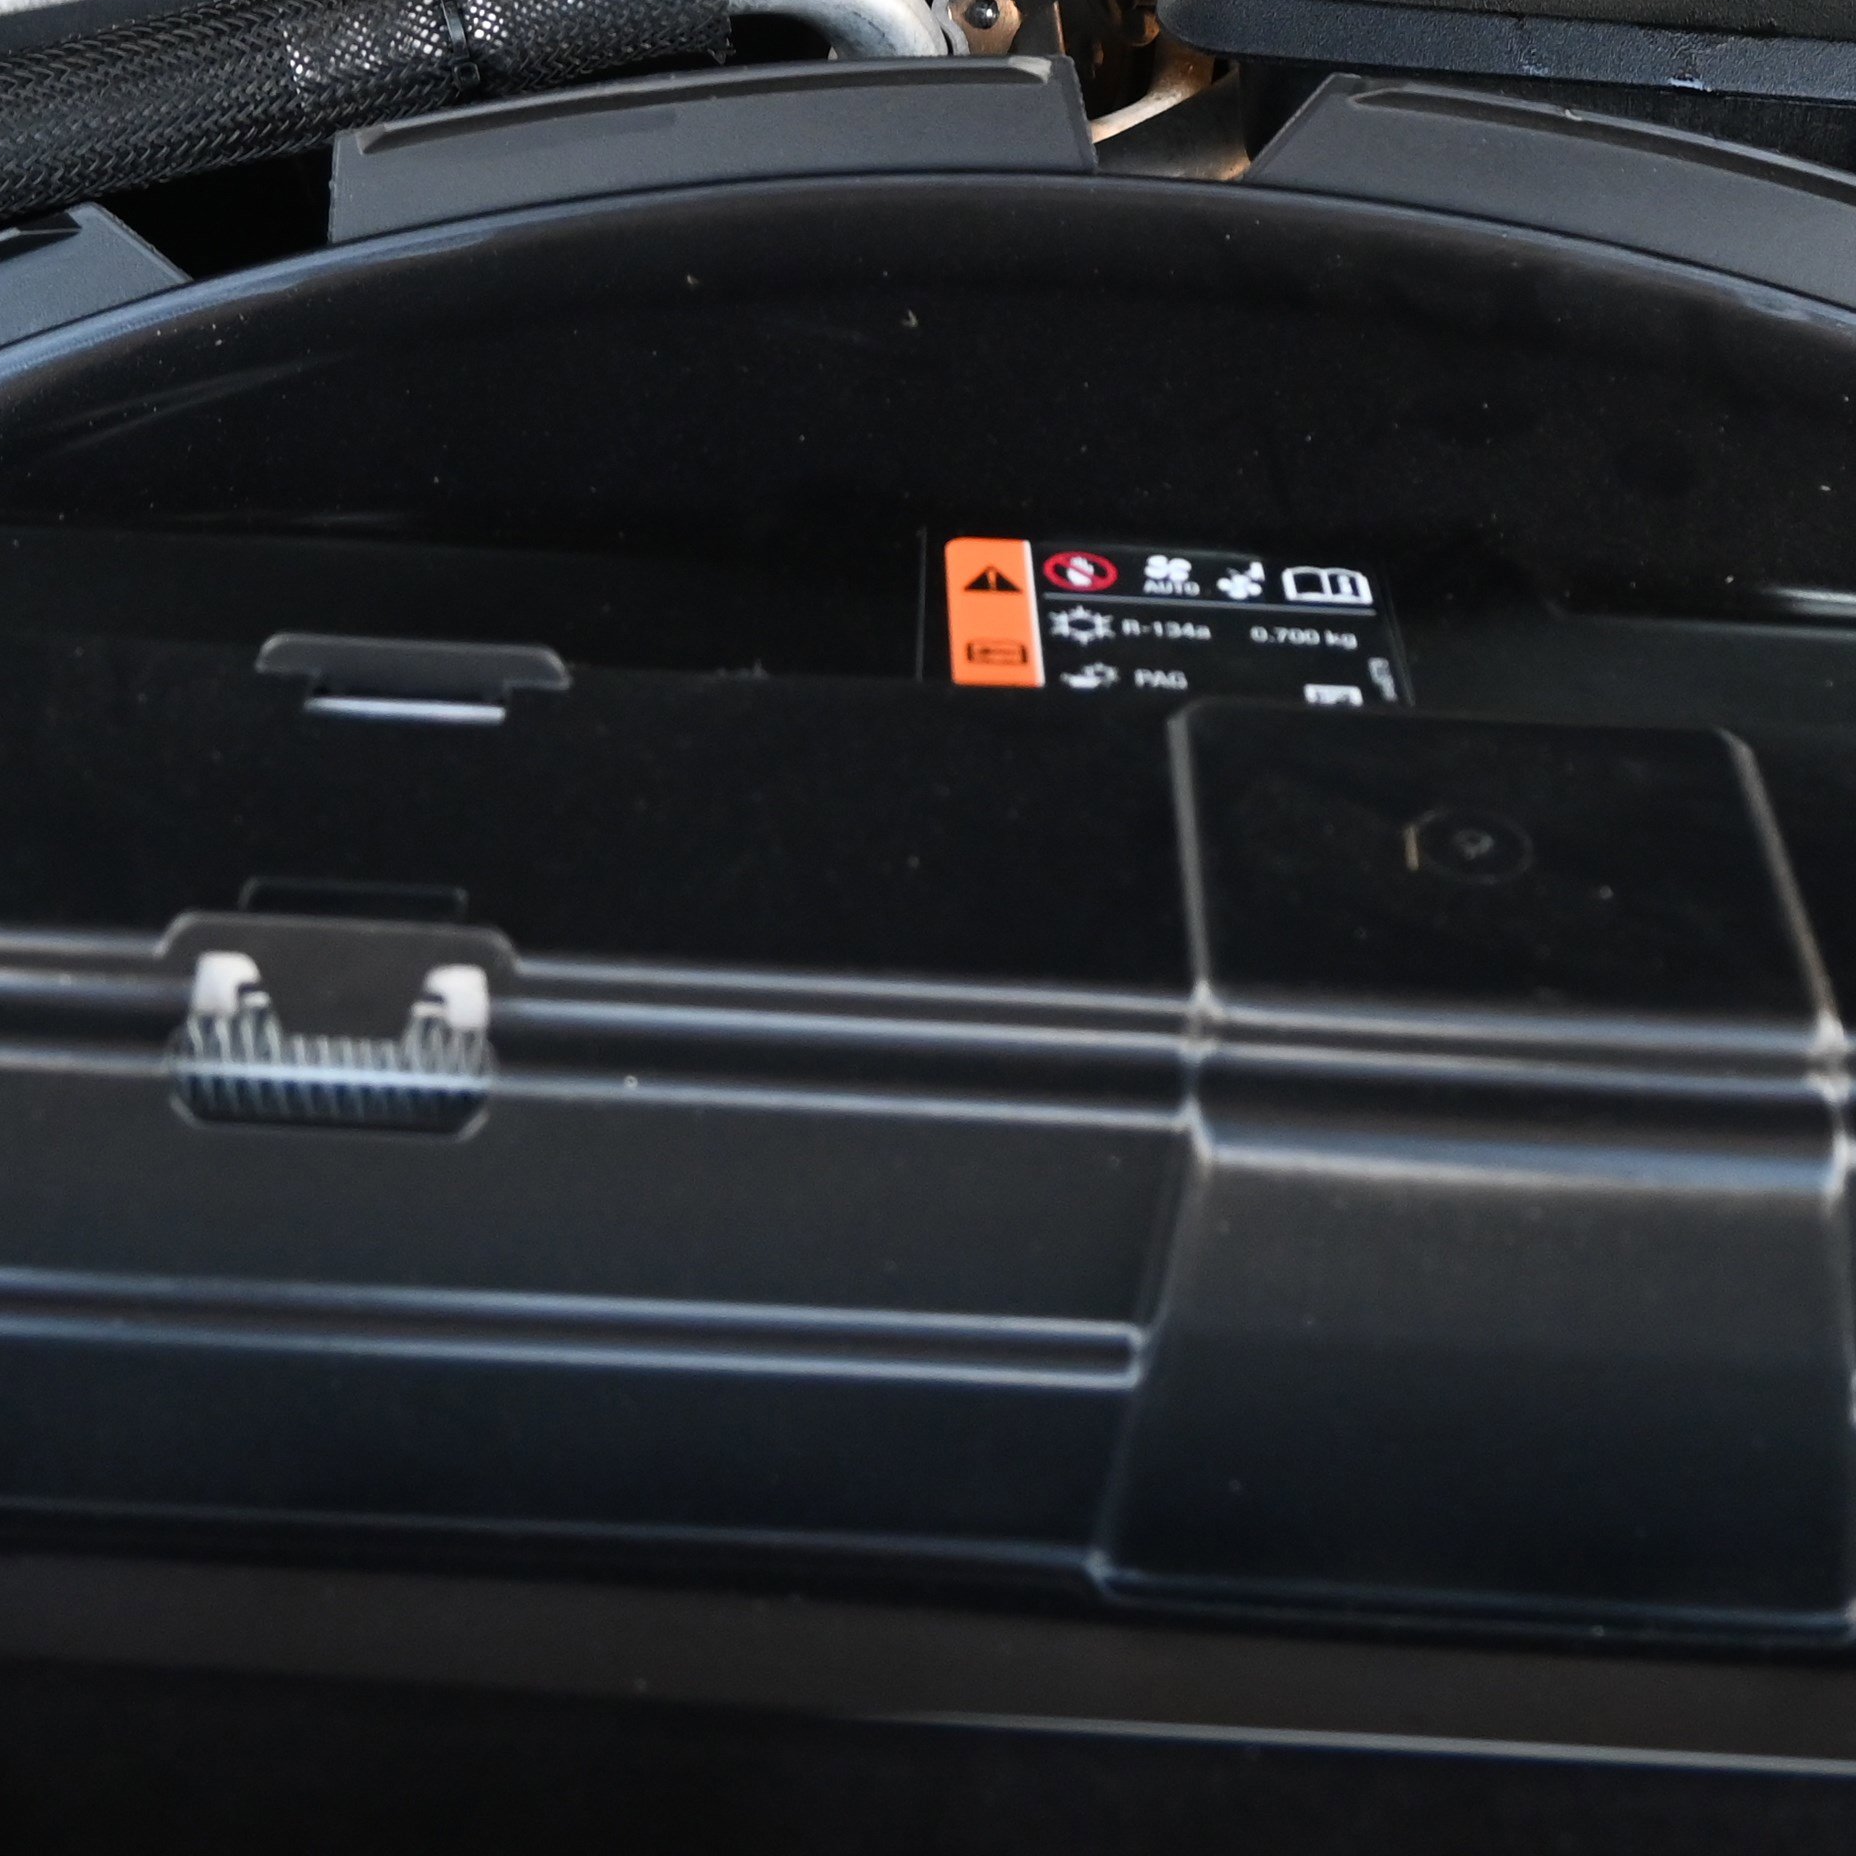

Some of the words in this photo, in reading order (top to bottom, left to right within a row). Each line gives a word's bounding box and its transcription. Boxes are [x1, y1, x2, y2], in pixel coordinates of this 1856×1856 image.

[1143, 578, 1201, 597] AUTO
[1122, 618, 1212, 640] R-134a
[1249, 625, 1321, 646] 0.700
[1134, 668, 1188, 691] PAG
